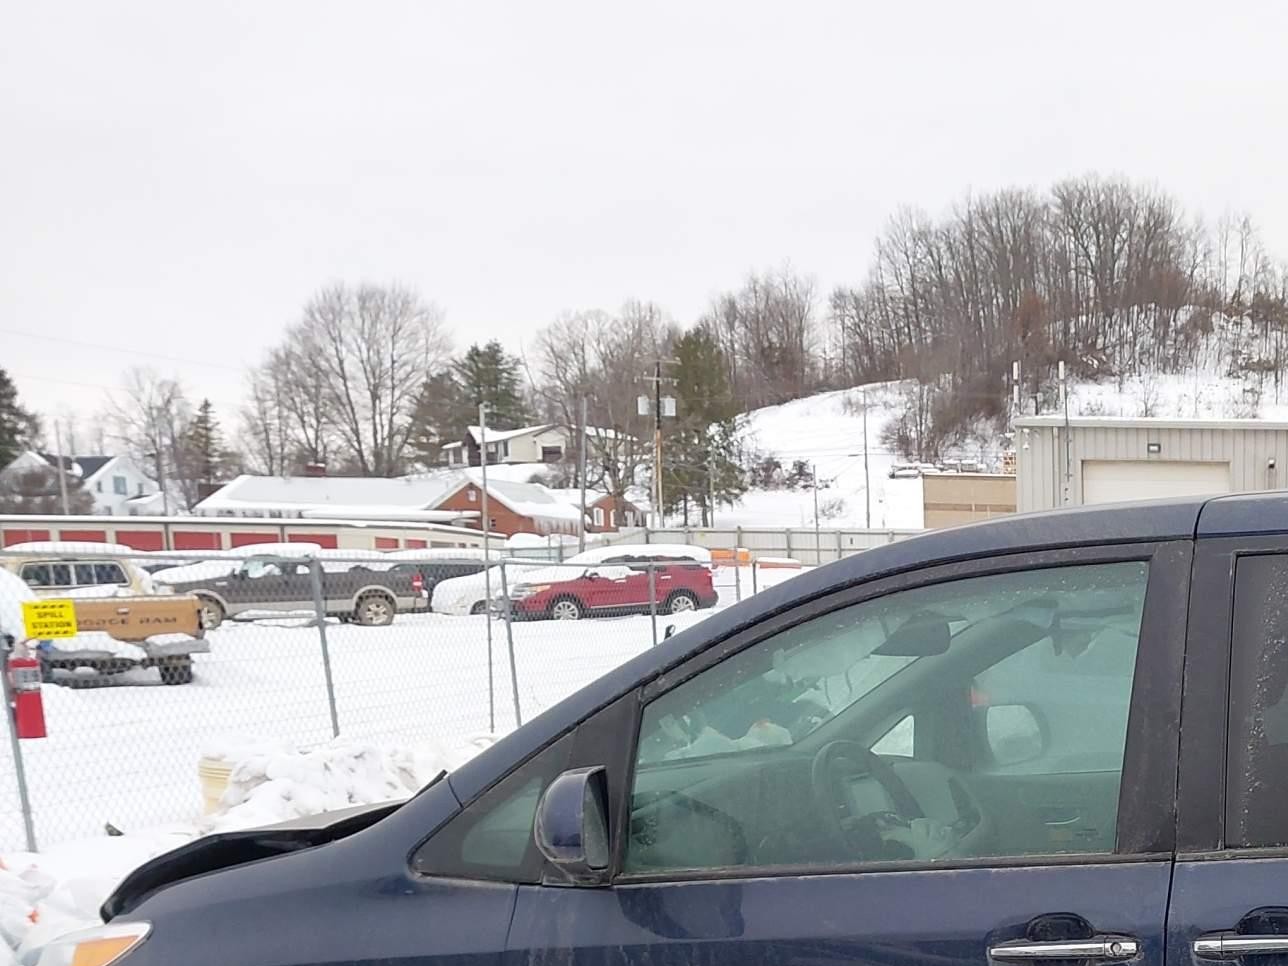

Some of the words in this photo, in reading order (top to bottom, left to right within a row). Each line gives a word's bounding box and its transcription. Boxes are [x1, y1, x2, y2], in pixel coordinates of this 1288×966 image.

[37, 611, 64, 619] SPILL
[139, 617, 178, 625] RAM
[32, 621, 73, 630] STATION
